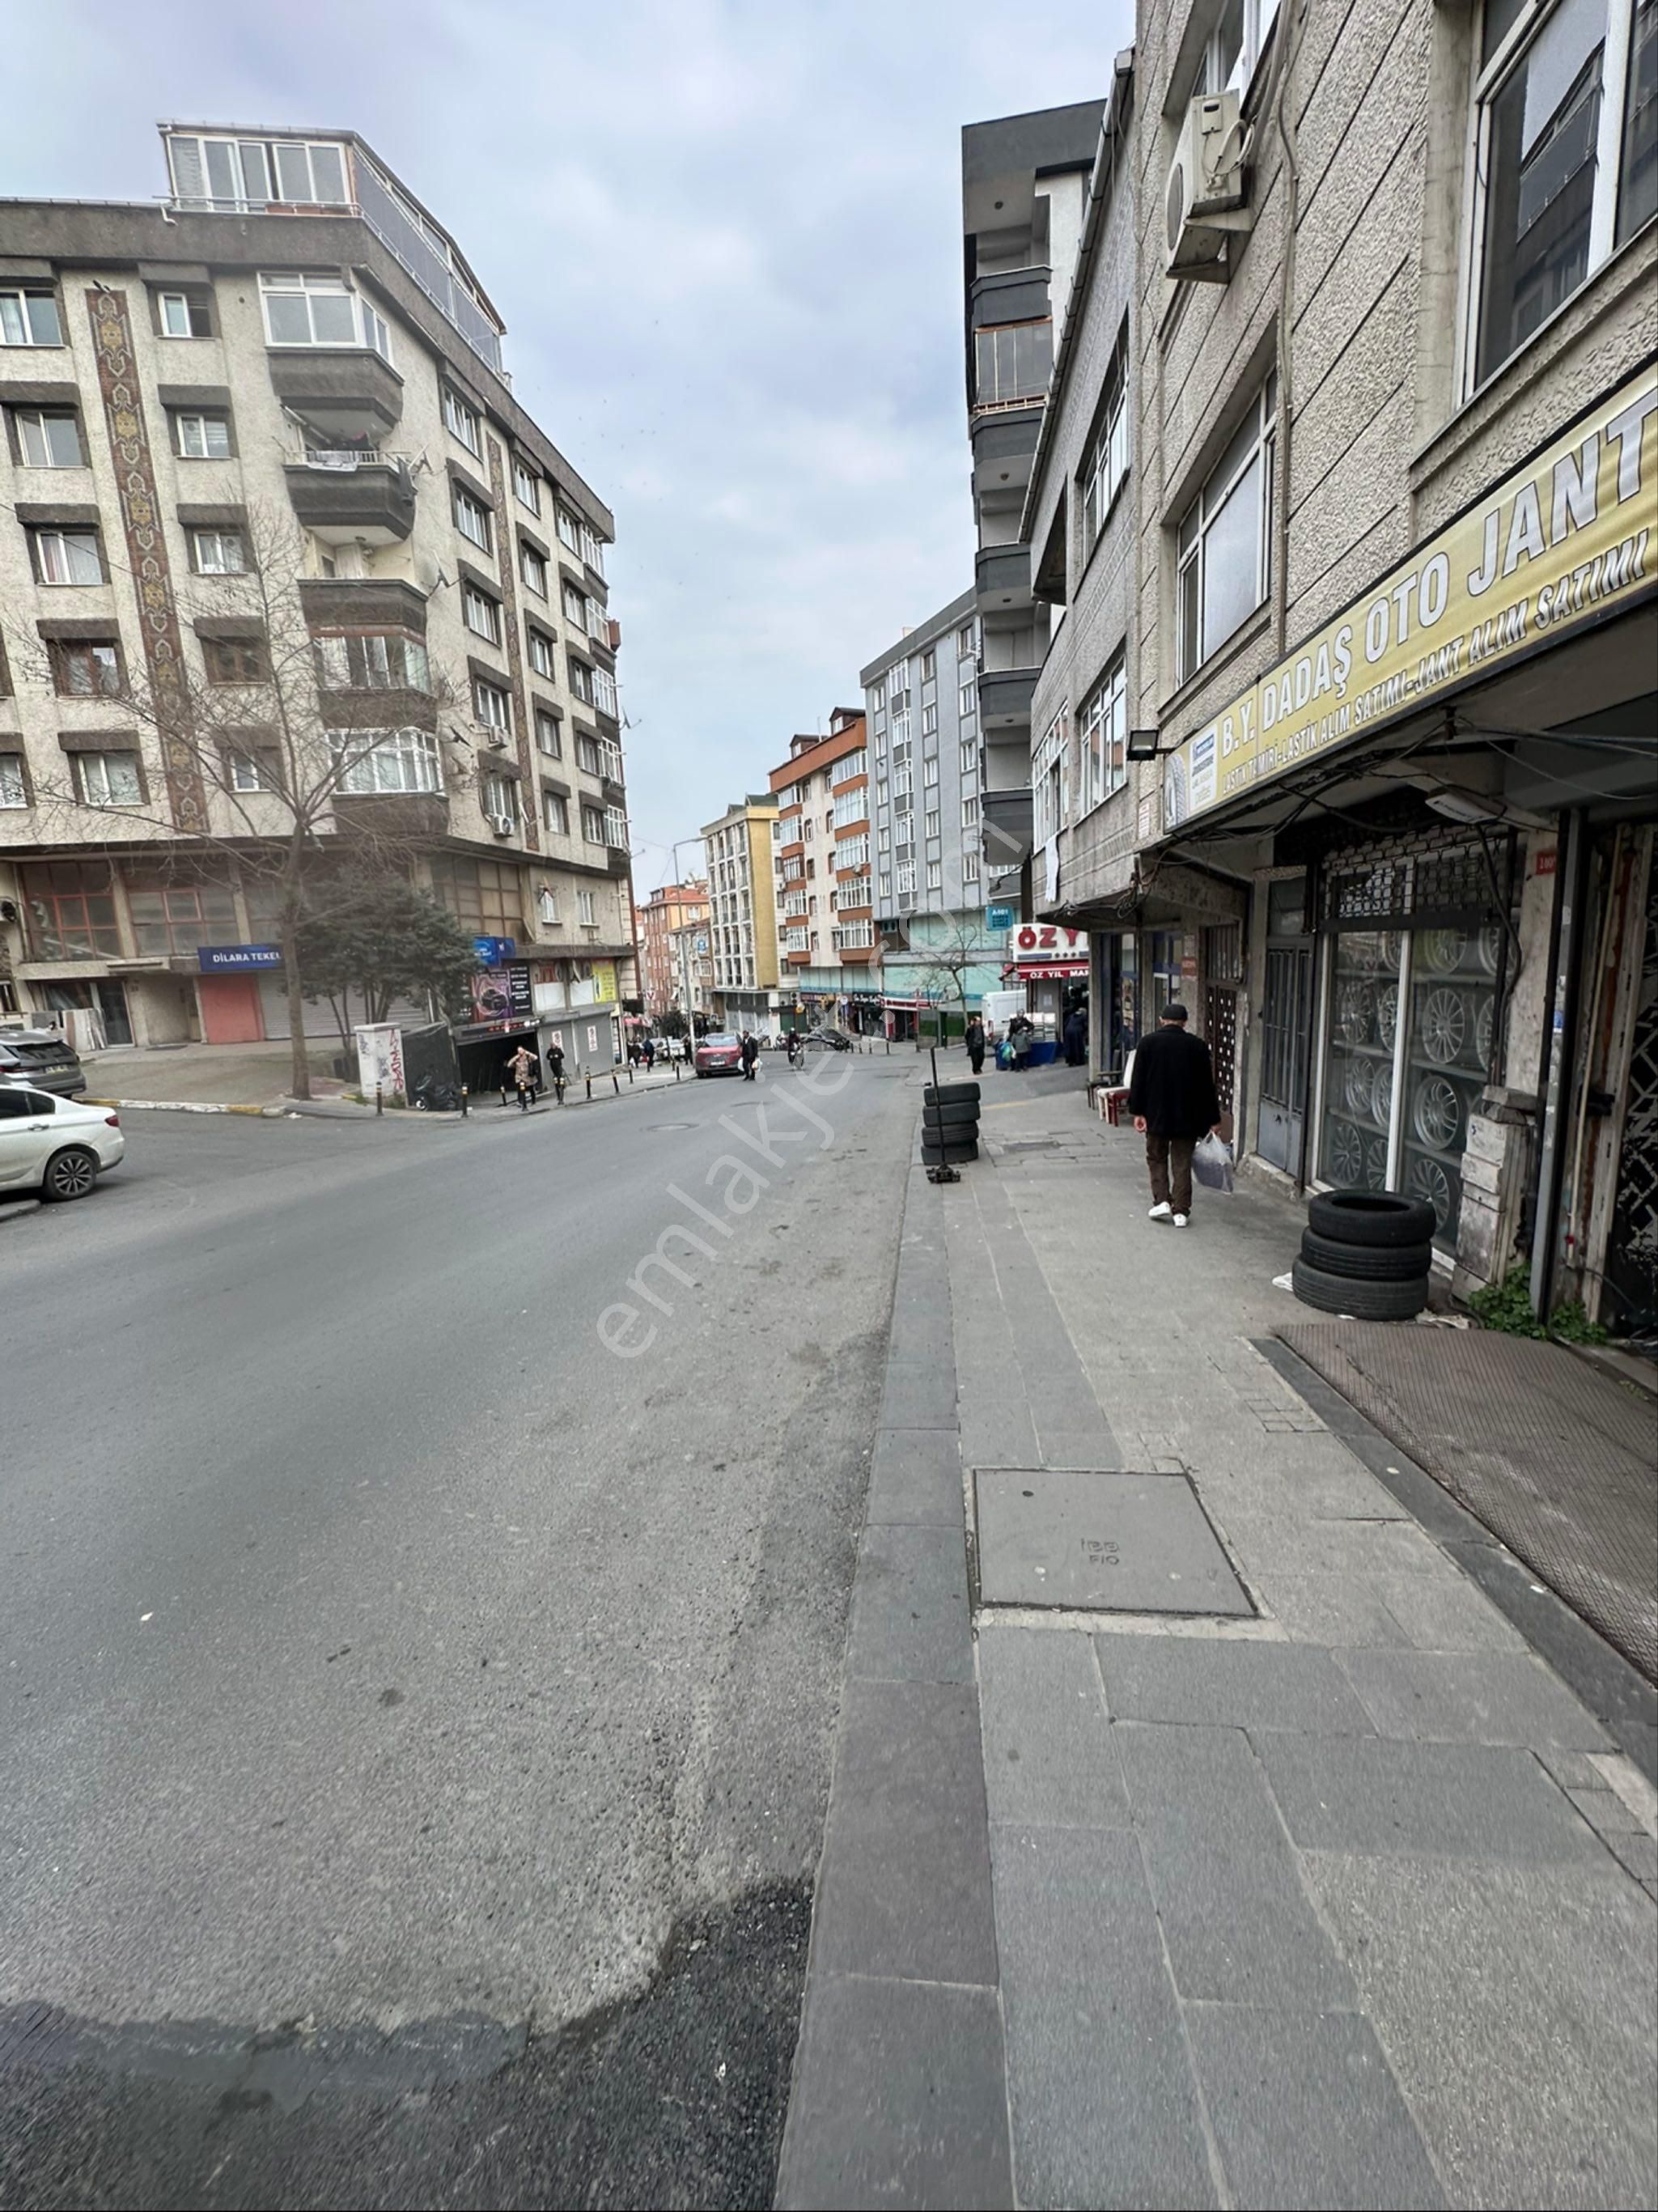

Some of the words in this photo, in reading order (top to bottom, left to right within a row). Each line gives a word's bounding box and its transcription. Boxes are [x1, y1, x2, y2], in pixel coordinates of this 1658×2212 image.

[1223, 698, 1255, 758] B.Y.
[1262, 624, 1352, 732] DADAŞ
[1364, 551, 1449, 664] OTO
[1467, 386, 1658, 597] JANT
[1320, 702, 1351, 745] ALIM
[1468, 597, 1529, 667] ALIM
[1533, 528, 1649, 630] SATIMI
[213, 952, 249, 963] DİLARA
